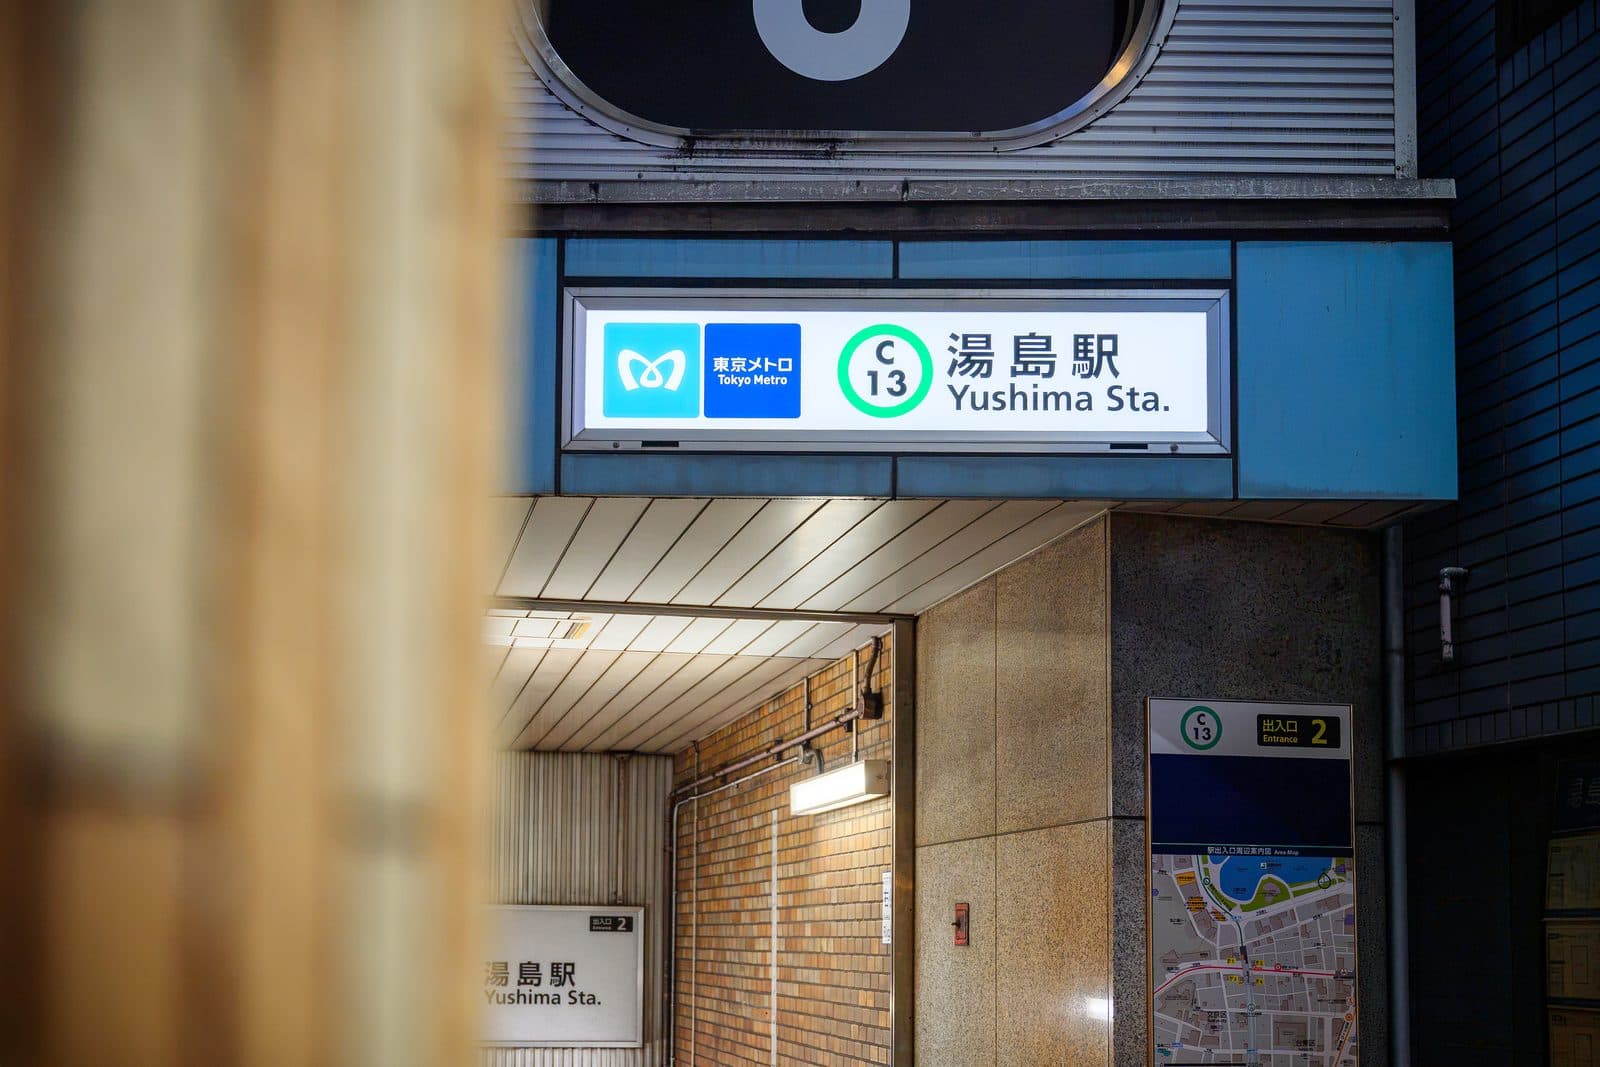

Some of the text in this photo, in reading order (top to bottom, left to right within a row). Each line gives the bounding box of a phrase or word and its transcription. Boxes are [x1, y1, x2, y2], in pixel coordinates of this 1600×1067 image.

[875, 340, 895, 366] C
[946, 332, 1120, 380] 湯島駅
[712, 356, 793, 374] 東京メトロ
[717, 374, 788, 388] Tokyo Metro
[866, 370, 907, 397] 13
[946, 383, 1170, 412] Yushima Sta.
[1197, 713, 1206, 726] C
[1262, 719, 1298, 733] 出入口
[1192, 727, 1211, 741] 13
[1263, 734, 1298, 744] Entrance
[1311, 719, 1328, 745] 2
[617, 918, 627, 931] 2
[484, 960, 576, 987] 湯島駅
[484, 989, 602, 1006] Yushima Sta.
